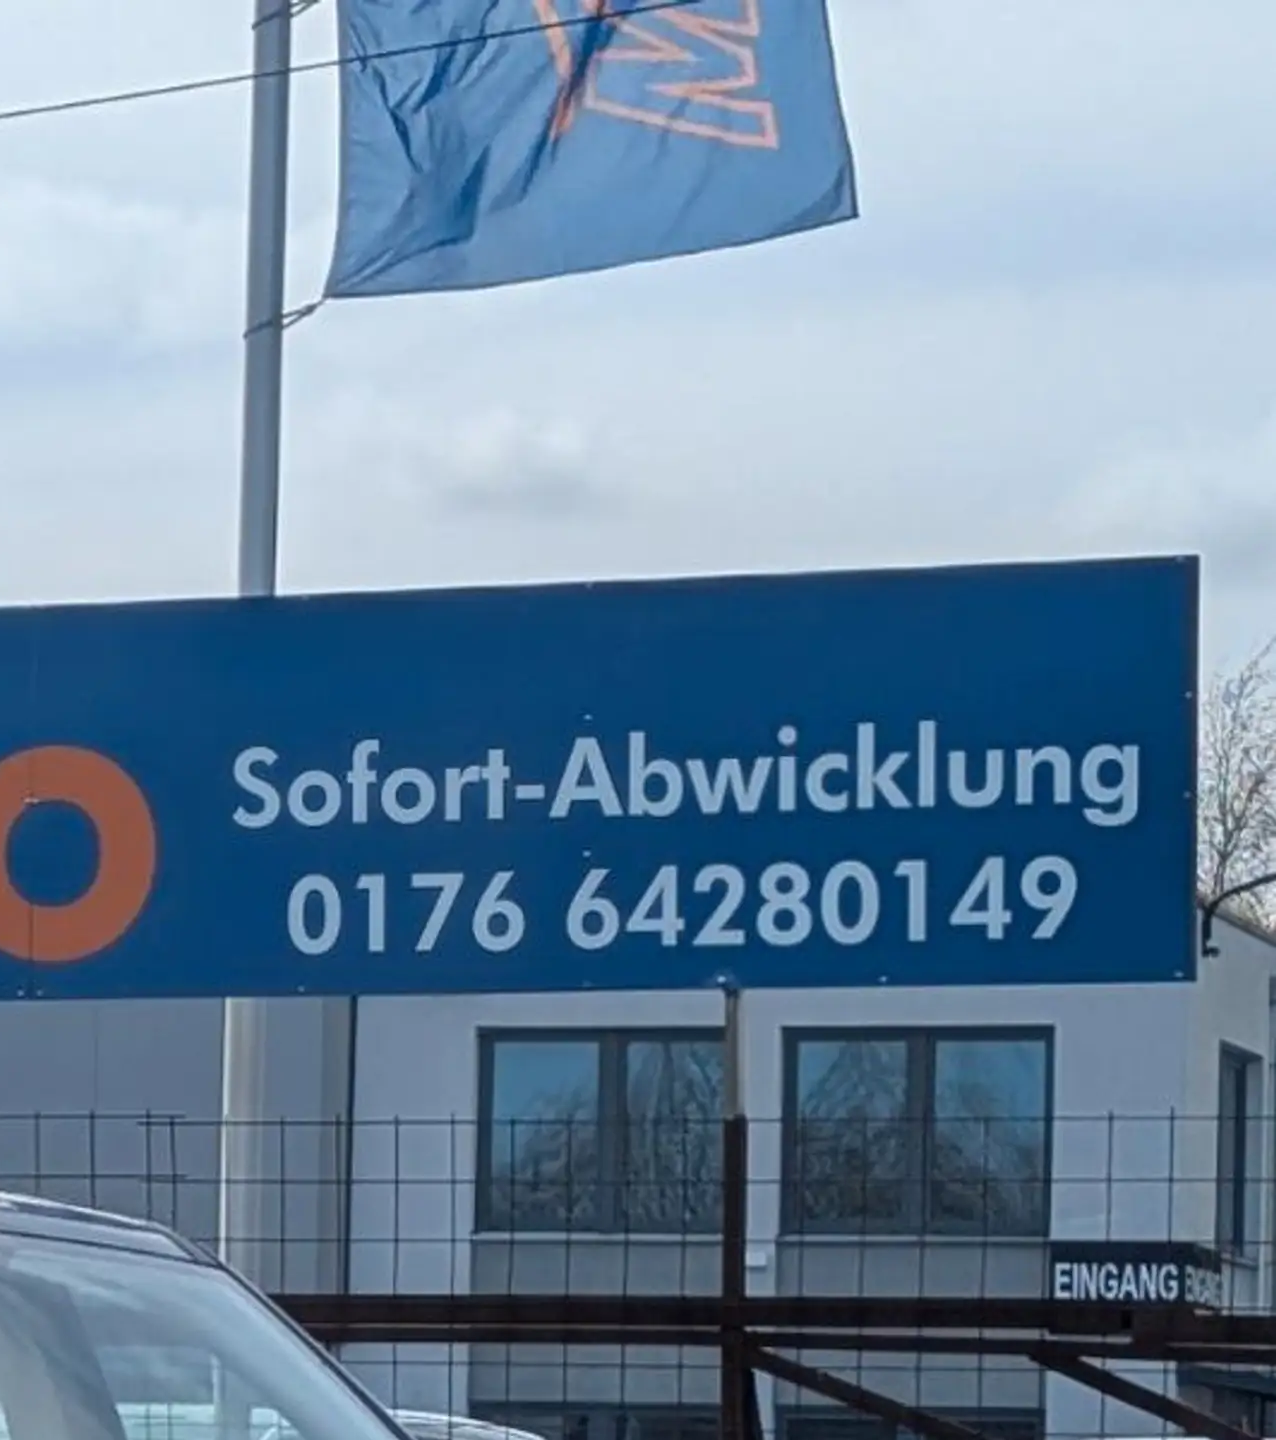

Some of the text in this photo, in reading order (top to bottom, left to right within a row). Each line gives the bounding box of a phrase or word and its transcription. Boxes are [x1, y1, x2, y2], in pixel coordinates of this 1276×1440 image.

[232, 720, 1139, 828] Sofort-Abwicklung
[287, 855, 1078, 955] 0176 64280149
[1053, 1261, 1179, 1301] EINGANG
